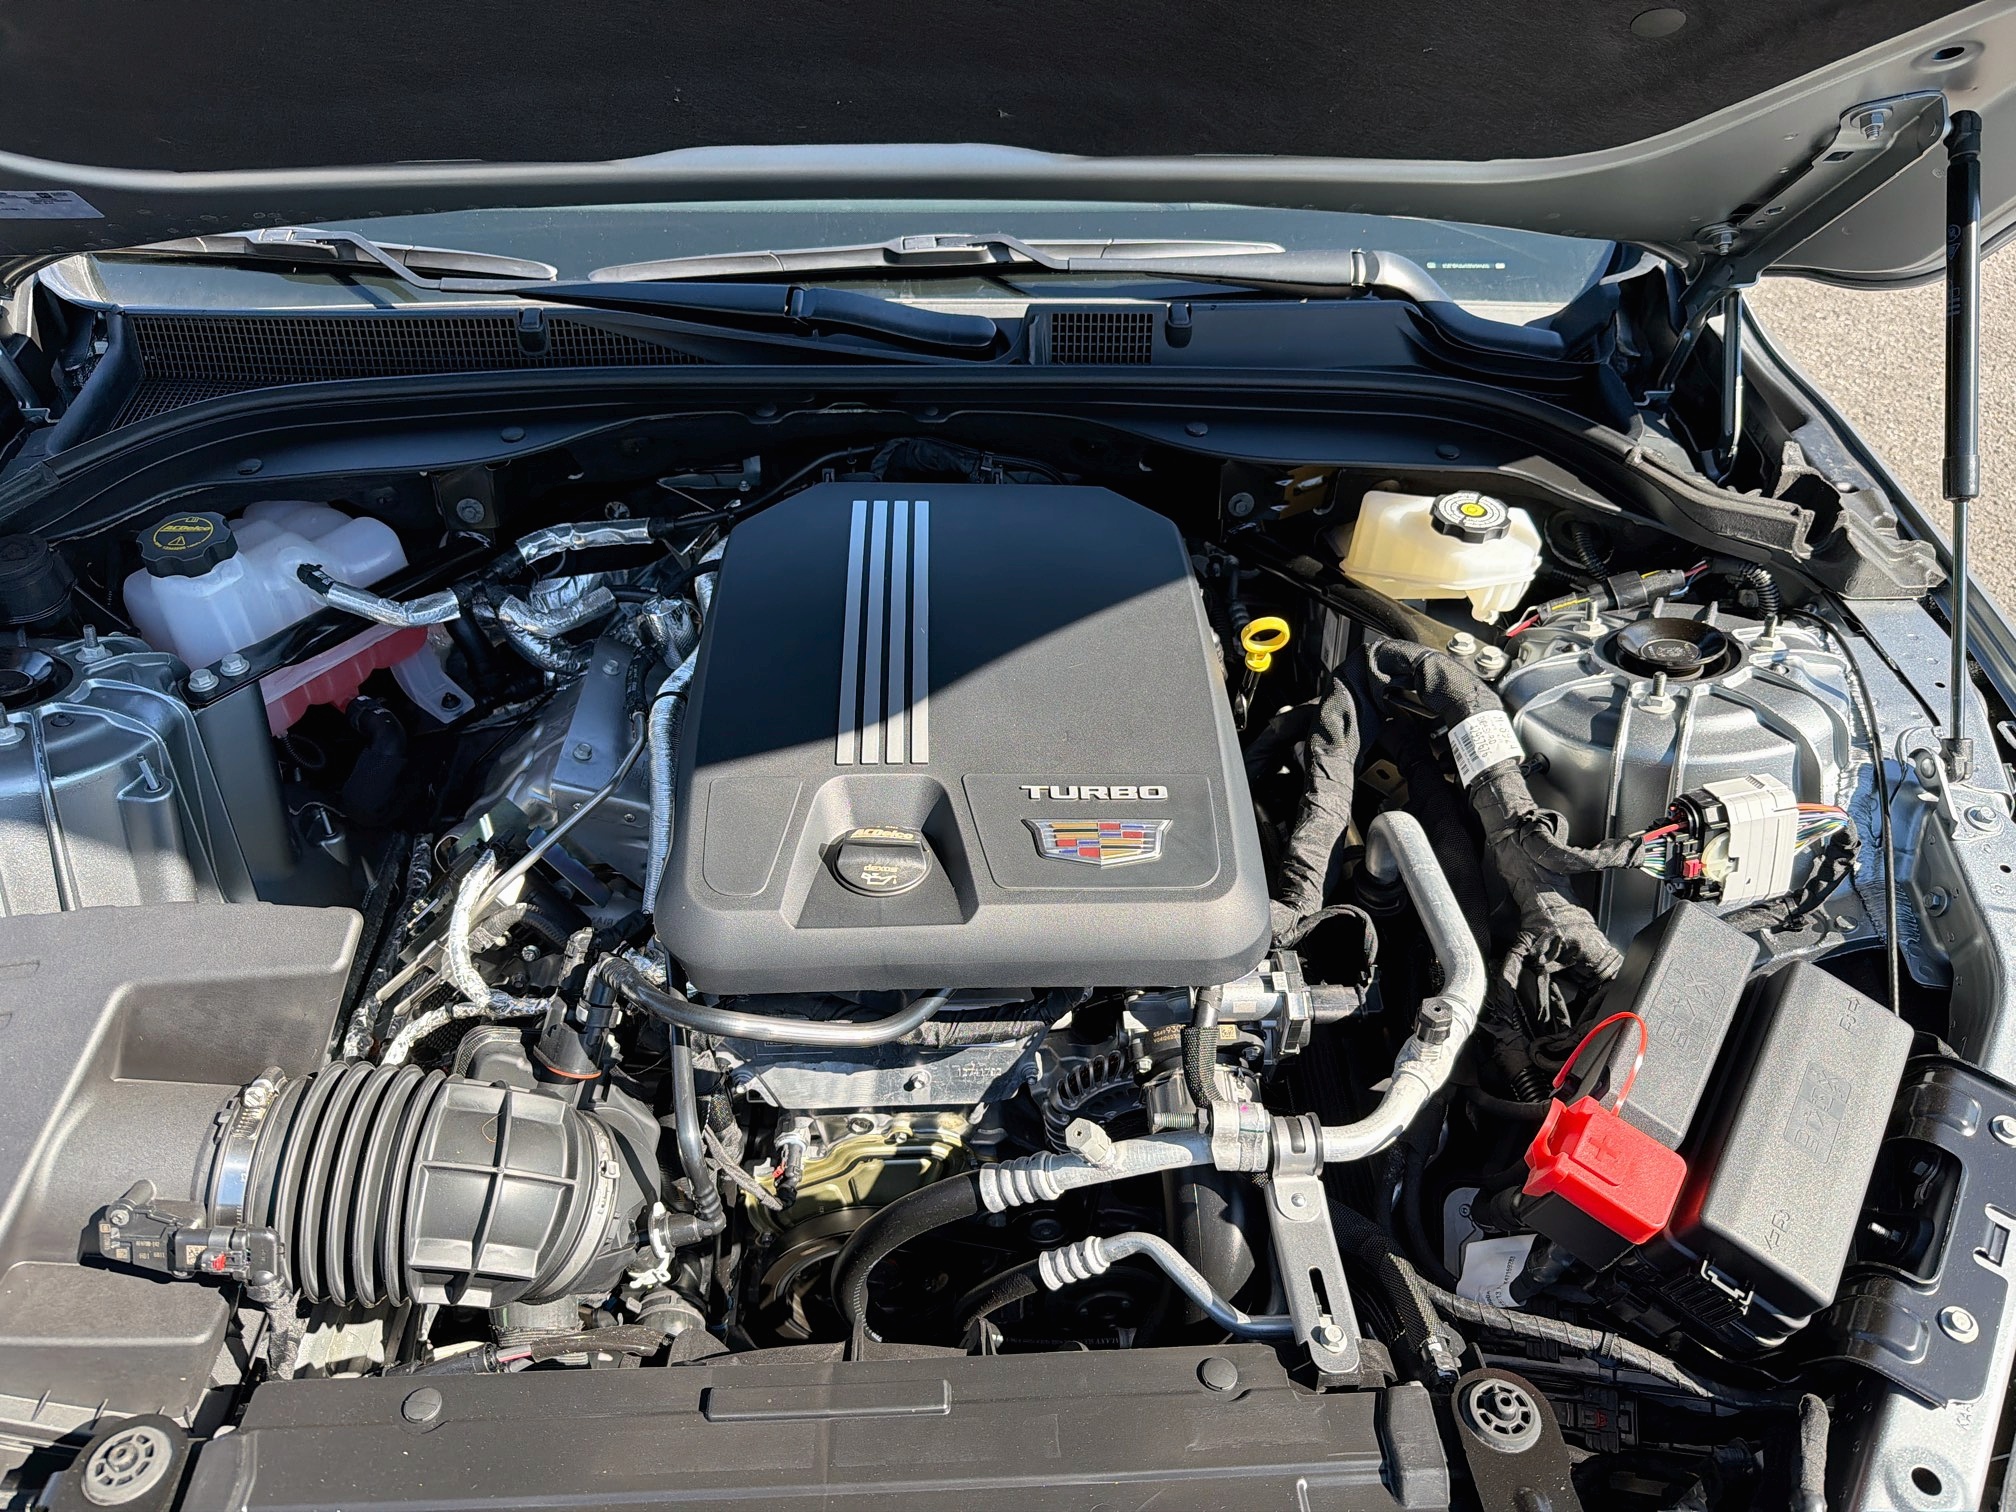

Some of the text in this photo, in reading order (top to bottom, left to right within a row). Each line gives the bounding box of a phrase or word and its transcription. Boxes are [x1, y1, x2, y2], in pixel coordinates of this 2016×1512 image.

[1020, 785, 1168, 800] TURBO
[850, 828, 914, 839] ACDelco
[864, 864, 898, 872] dexos
